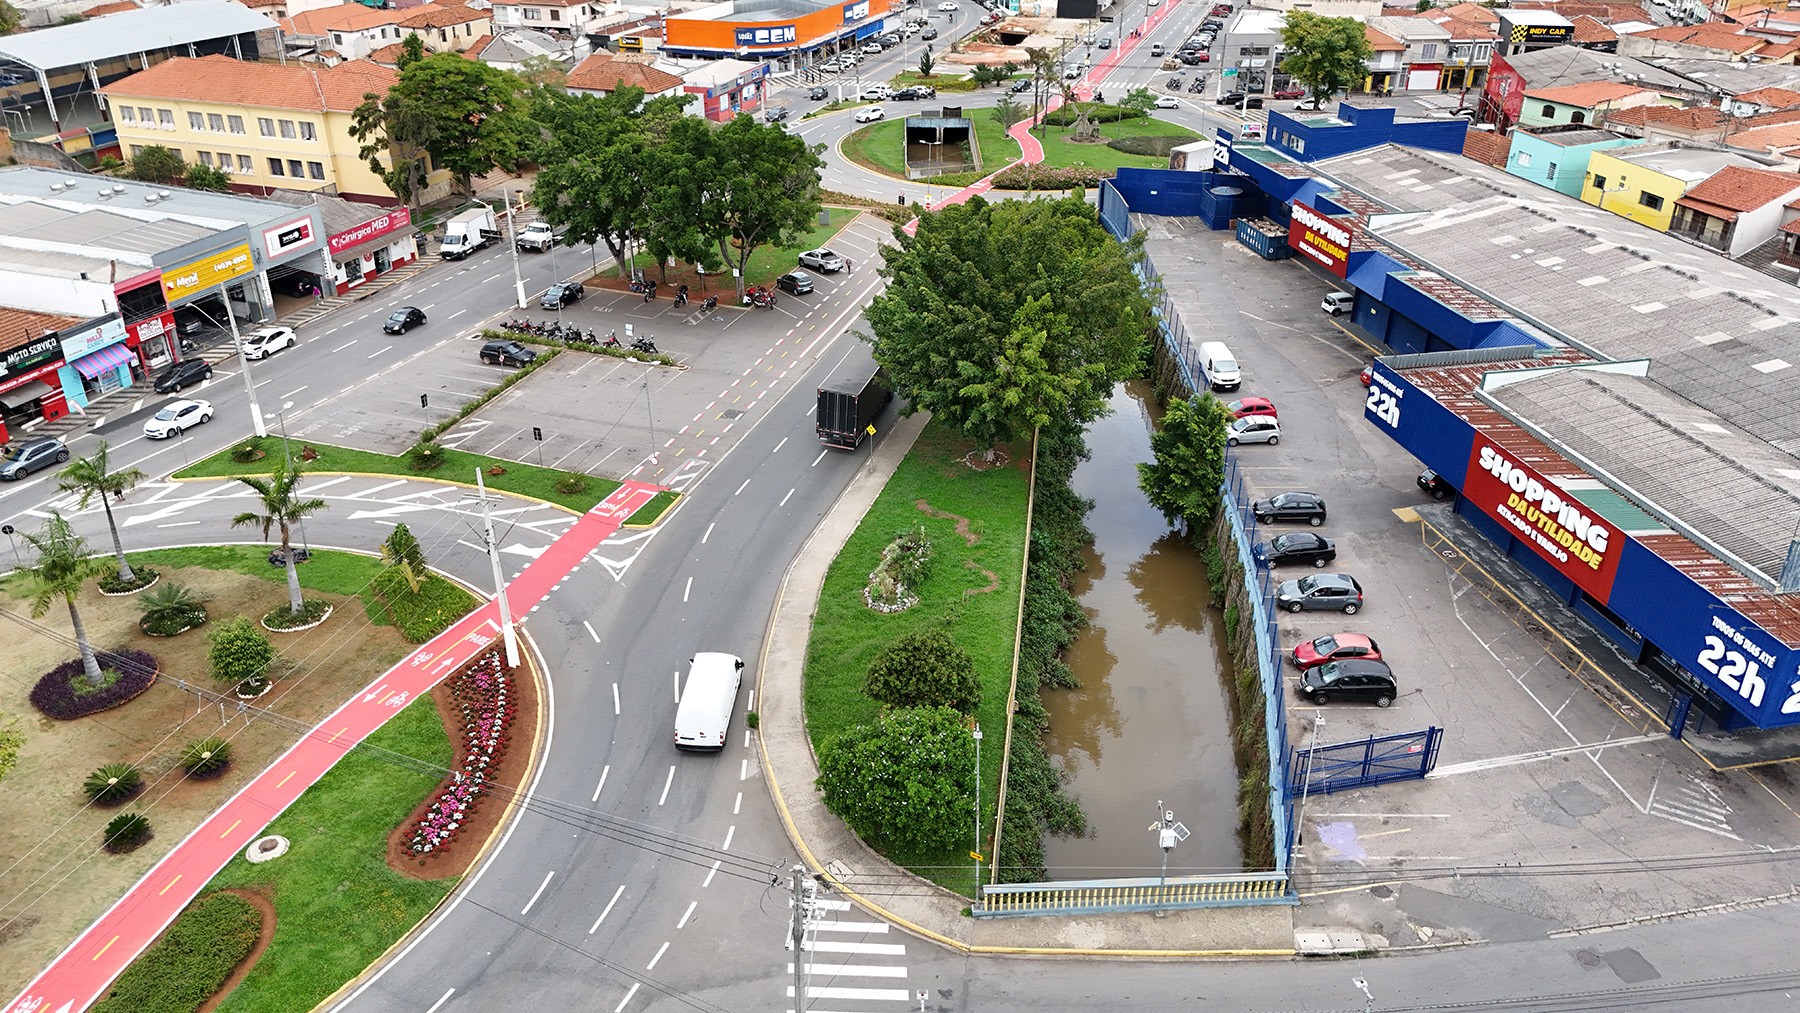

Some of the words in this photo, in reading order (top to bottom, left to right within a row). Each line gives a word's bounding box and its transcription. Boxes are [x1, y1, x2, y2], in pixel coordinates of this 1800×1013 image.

[755, 27, 796, 43] CEM
[371, 216, 389, 231] MED
[1291, 204, 1350, 248] SHOPPING
[1305, 230, 1314, 243] DA
[1314, 235, 1348, 262] UTILIDADE
[7, 348, 28, 364] MOTO
[29, 337, 57, 355] SERVIÇO
[1366, 385, 1400, 428] 22h
[1478, 446, 1609, 553] SHOPPING
[1497, 504, 1531, 535] ATACADO
[1530, 531, 1537, 540] E
[1536, 532, 1568, 563] VAREJO
[1507, 493, 1526, 516] DA
[1526, 506, 1603, 571] UTILIDADE
[465, 633, 491, 646] PARE
[1712, 615, 1735, 638] TODOS
[1733, 632, 1745, 645] OS
[1742, 638, 1761, 657] DIAS
[1758, 651, 1777, 668] ATÉ
[1697, 635, 1766, 707] 22h
